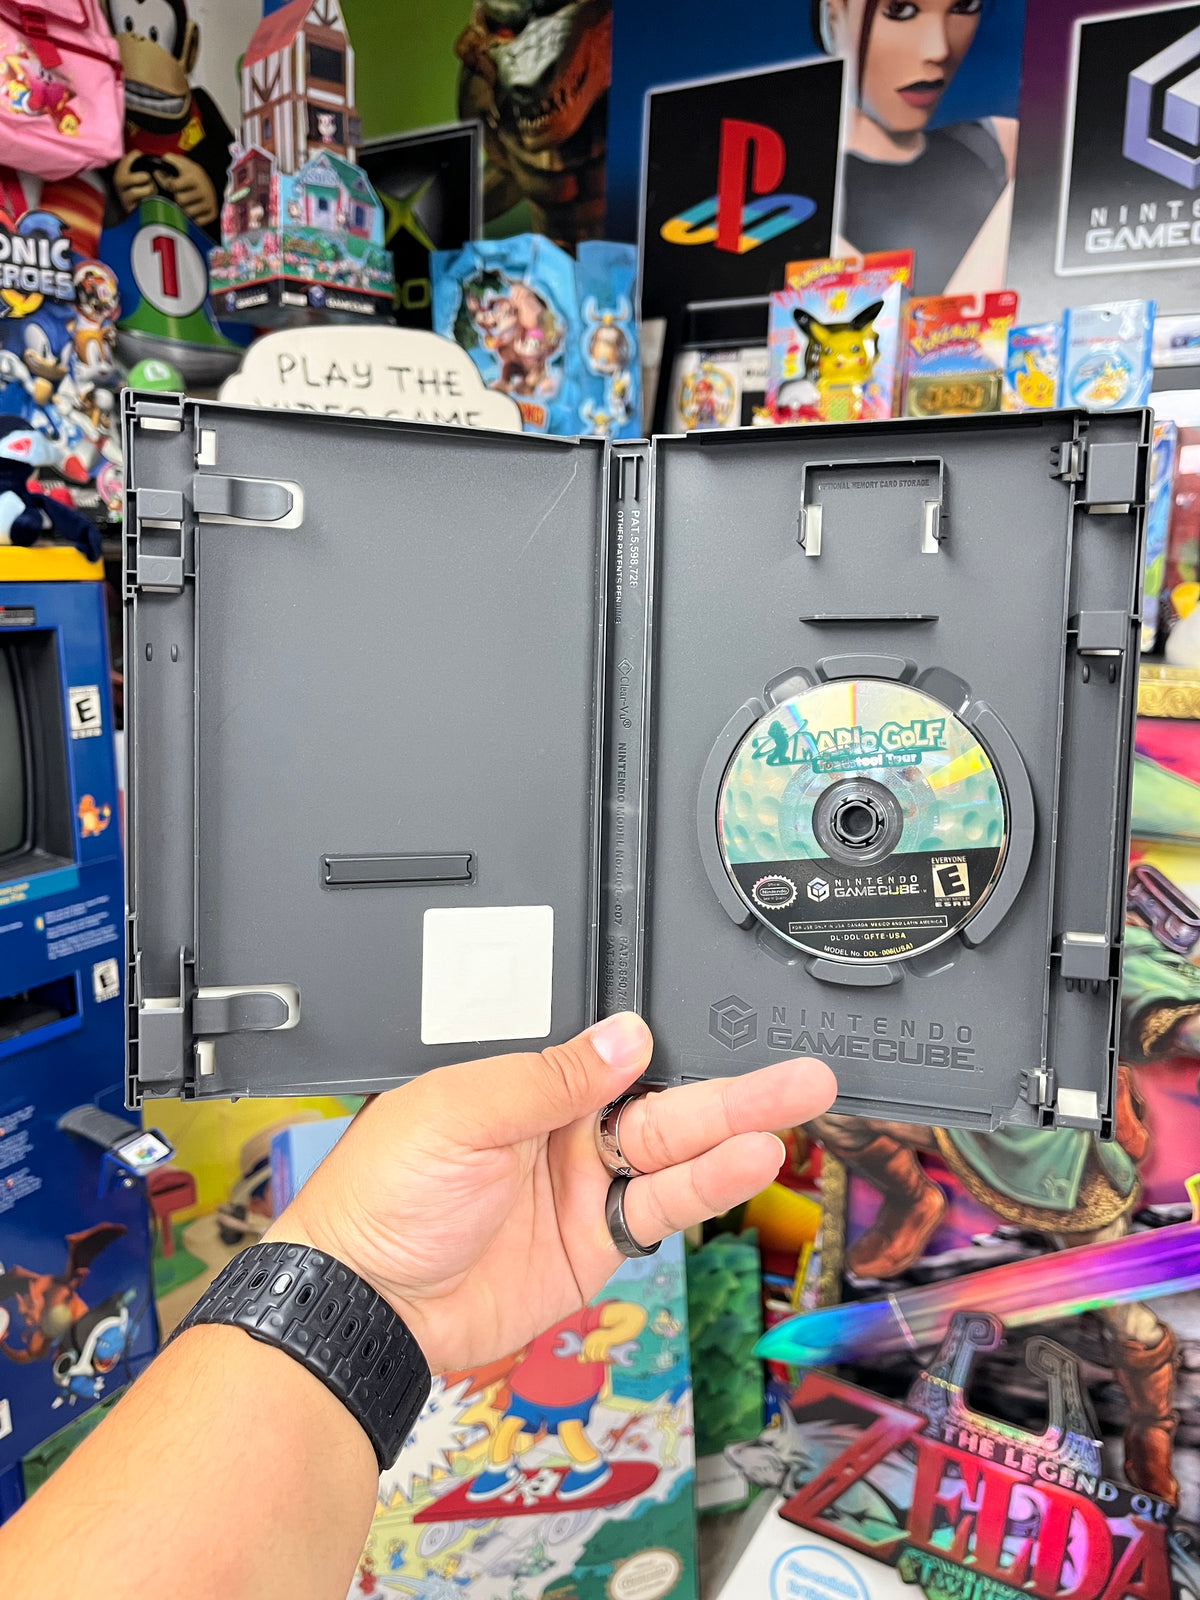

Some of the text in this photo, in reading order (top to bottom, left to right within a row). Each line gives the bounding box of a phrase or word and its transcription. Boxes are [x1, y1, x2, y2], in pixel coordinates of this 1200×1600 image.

[0, 263, 76, 301] ROES
[153, 236, 178, 298] 1
[277, 353, 463, 397] PLAY THE
[819, 479, 930, 490] OPTIONAL MEMORY CARD STORAGE
[616, 510, 624, 541] OTHER
[615, 544, 623, 584] PATENTS
[76, 698, 96, 723] E
[880, 718, 945, 752] GOLF
[616, 742, 627, 803] NINTENDO
[886, 752, 918, 765] Tour
[931, 855, 967, 864] EVERYONE
[834, 875, 918, 887] NINTENDO
[834, 884, 920, 897] GAMECUBE
[936, 865, 966, 896] E
[823, 945, 849, 956] MODEL
[771, 1006, 973, 1044] NINTENDO
[766, 1027, 976, 1072] GAMECUBE
[942, 1424, 995, 1459] THE
[1003, 1446, 1119, 1501] LEGEND
[778, 1373, 1172, 1600] ZELDA
